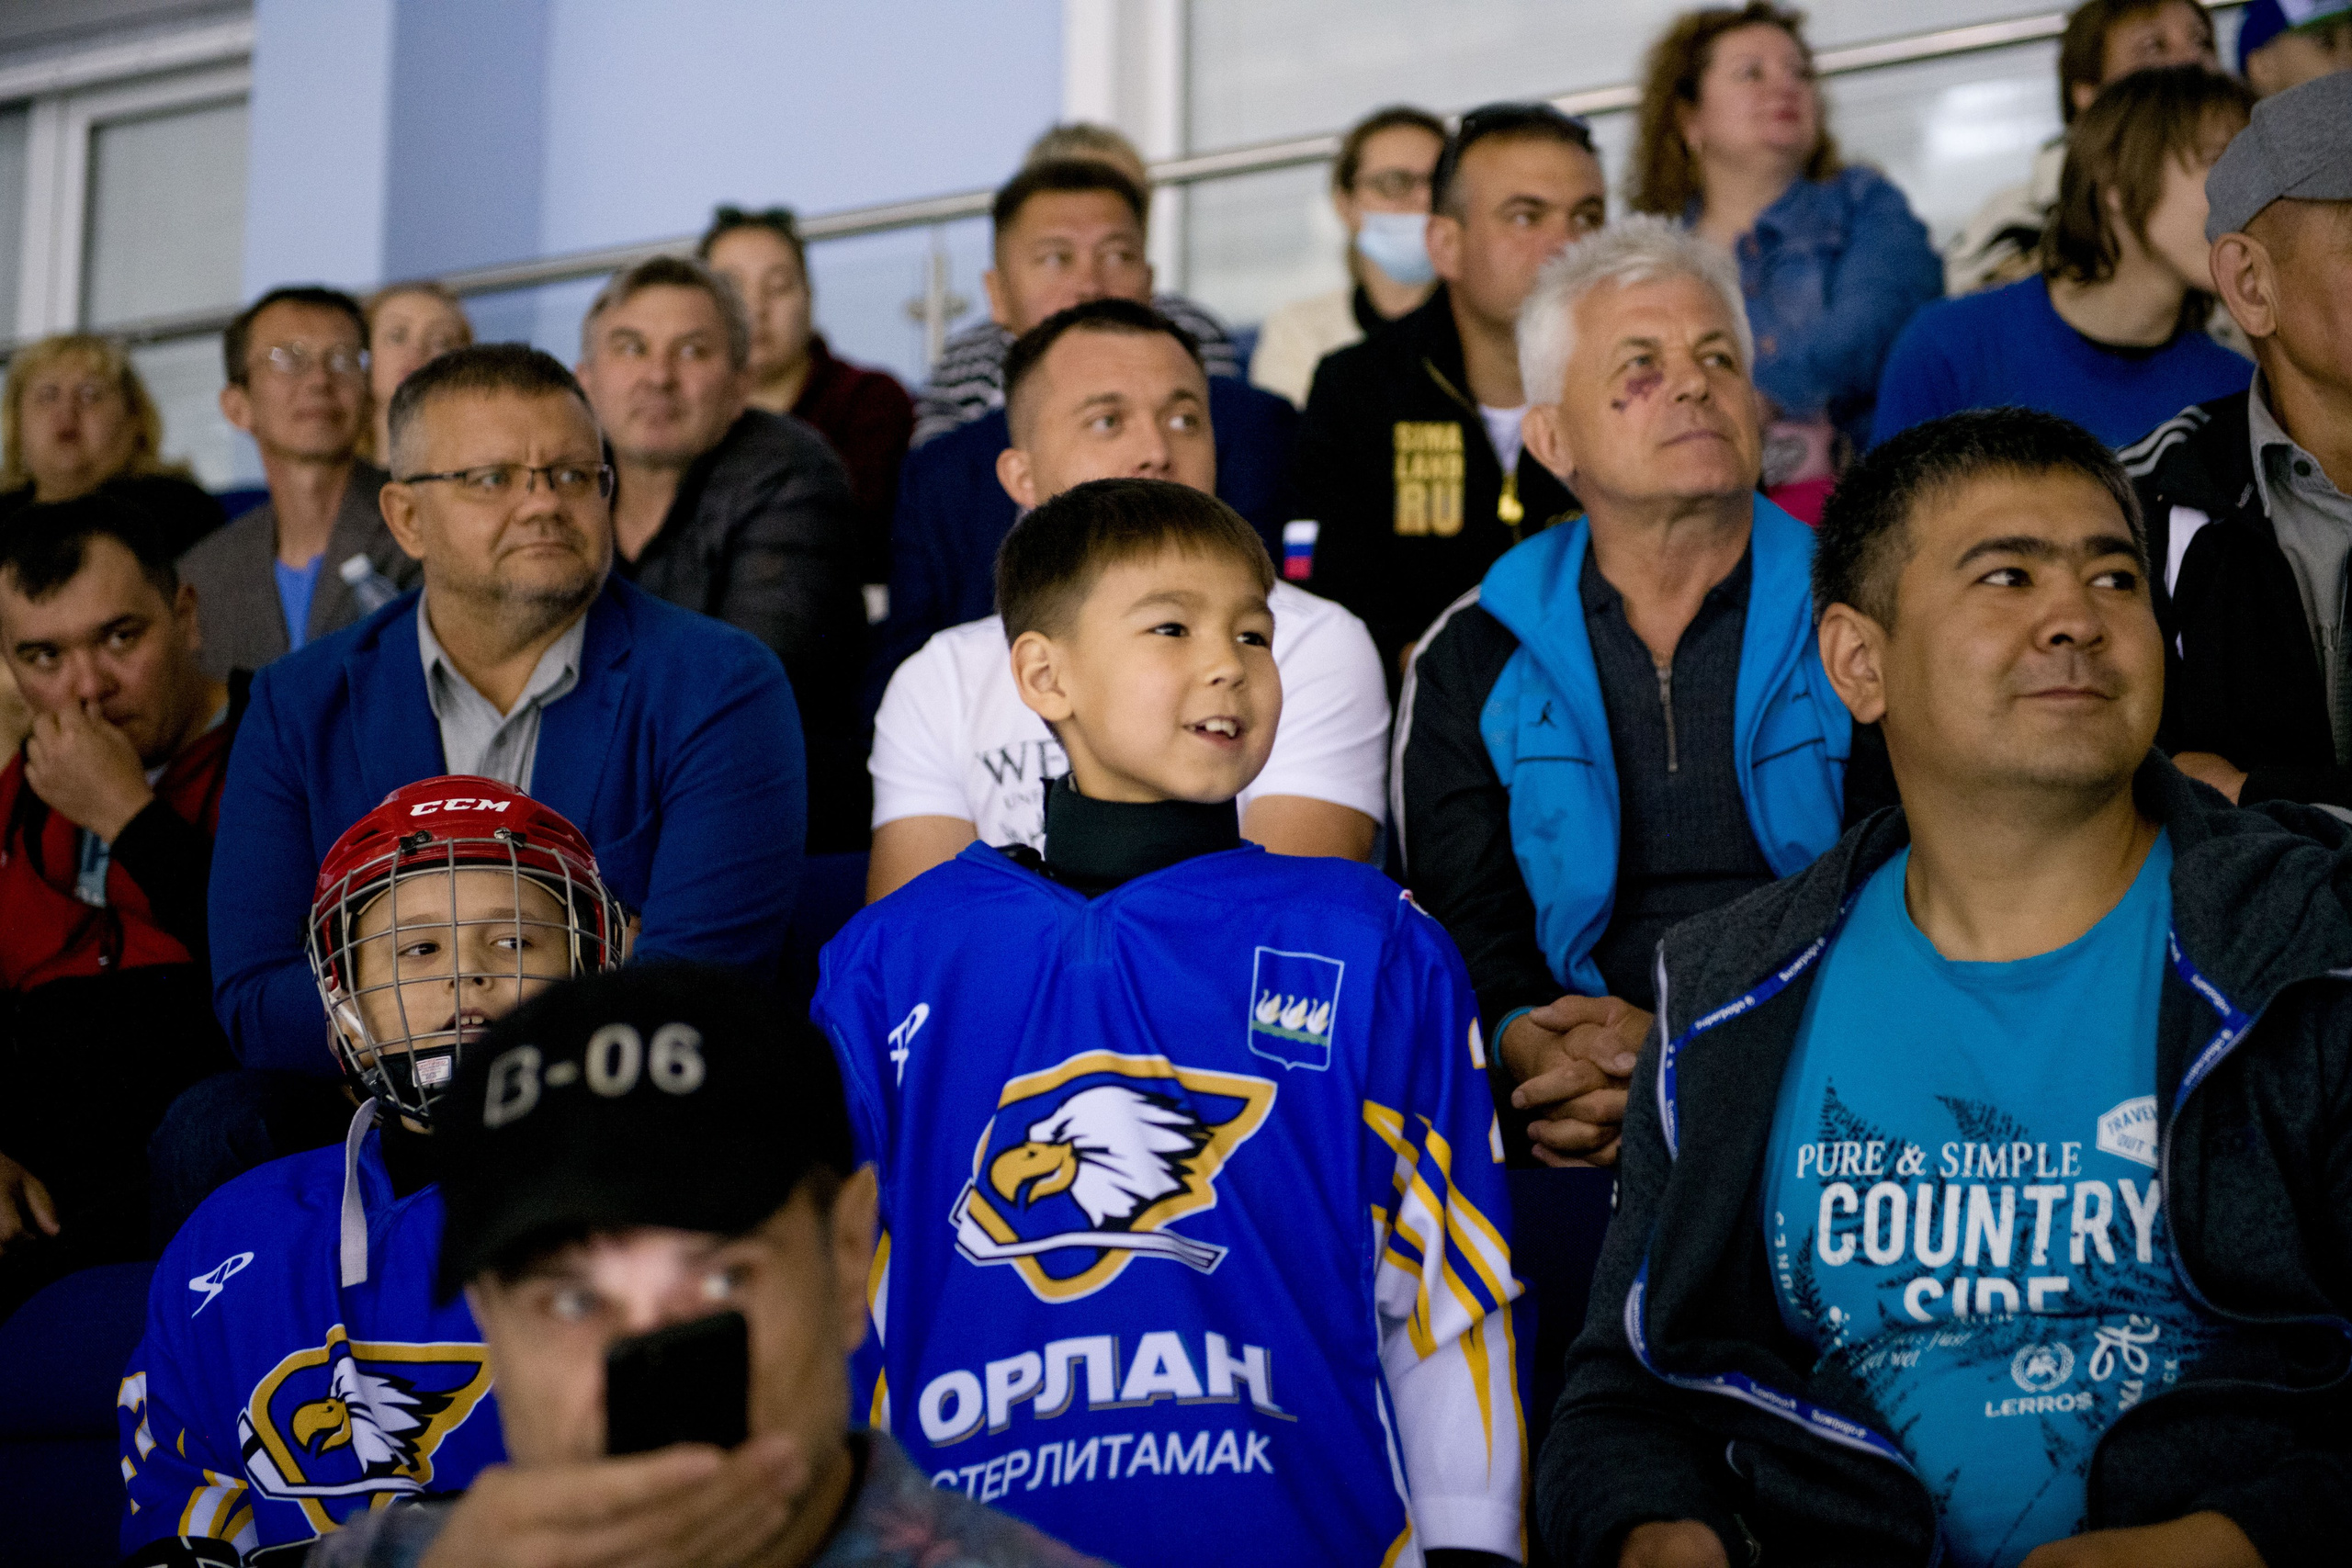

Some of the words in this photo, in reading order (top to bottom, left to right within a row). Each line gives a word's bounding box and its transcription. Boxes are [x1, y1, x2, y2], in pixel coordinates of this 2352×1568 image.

[1393, 480, 1464, 537] RU
[410, 797, 511, 817] CCM
[482, 1021, 707, 1130] B-06
[1796, 1140, 1886, 1179] PURE
[1895, 1143, 1927, 1178] &
[1939, 1141, 2083, 1179] SIMPLE
[1816, 1179, 2161, 1268] COUNTRY
[919, 1330, 1297, 1448] ОРЛАН
[1985, 1391, 2093, 1417] LERROS
